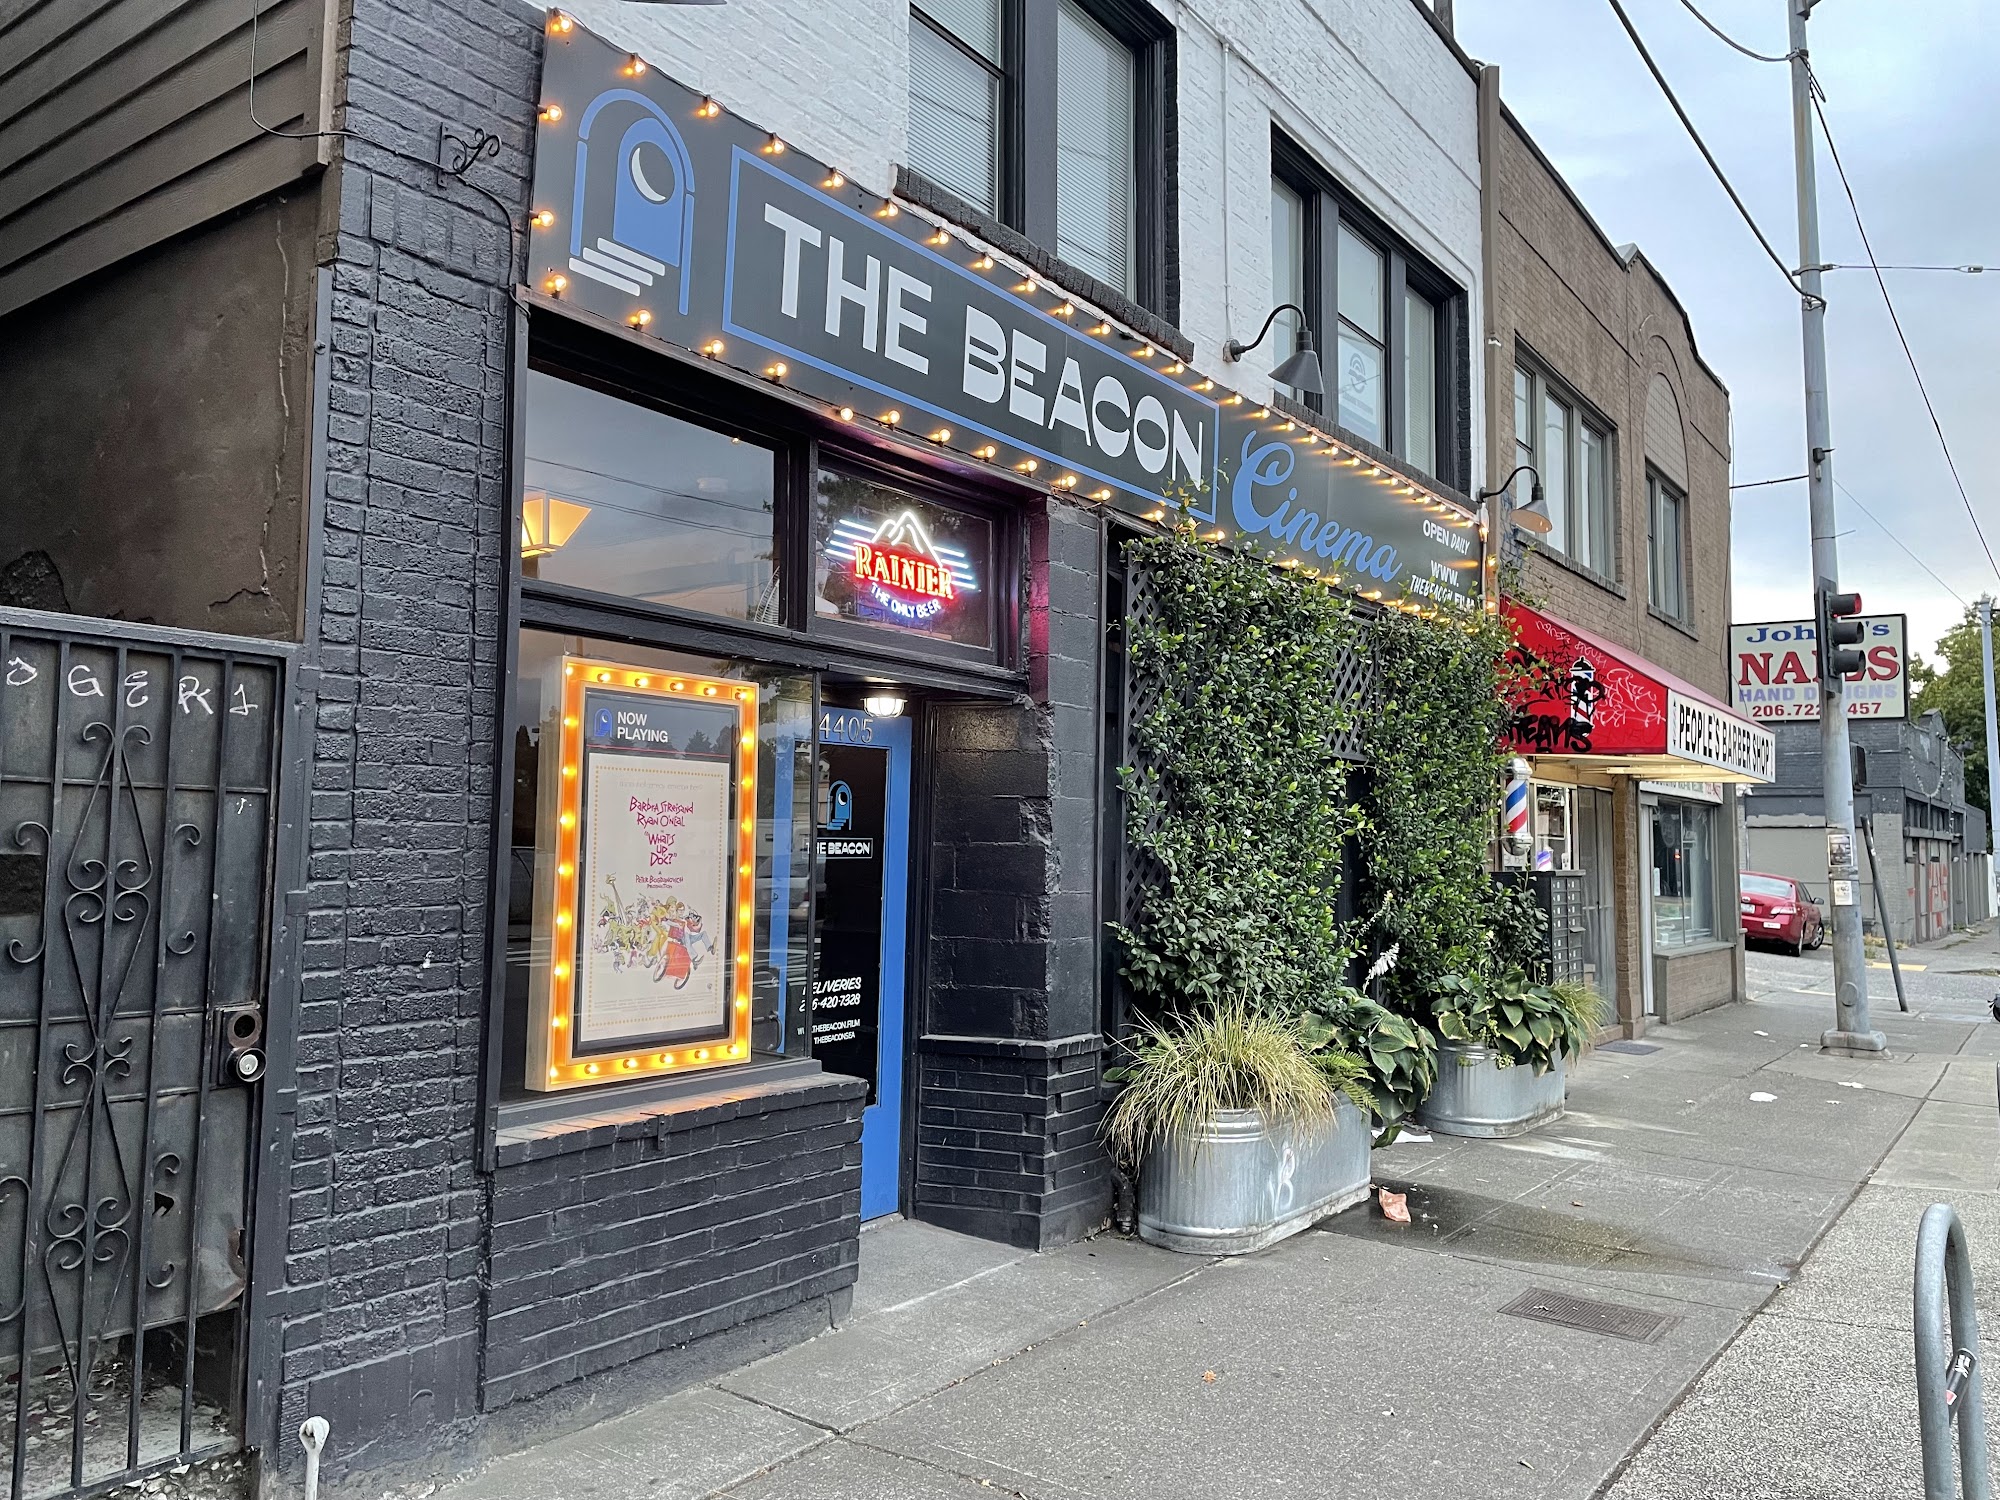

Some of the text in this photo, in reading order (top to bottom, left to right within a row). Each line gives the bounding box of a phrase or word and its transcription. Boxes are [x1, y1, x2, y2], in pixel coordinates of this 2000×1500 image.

[763, 203, 1203, 491] THE BEACON
[1232, 430, 1402, 582] Cinema
[1423, 519, 1470, 555] OPEN DAILY
[853, 542, 954, 600] RAINIER
[1431, 560, 1459, 587] WWW.
[871, 582, 942, 619] THE ONLY BEER
[1738, 646, 1900, 686] NAS
[1739, 684, 1897, 703] HAND DIGNS
[617, 711, 647, 726] NOW
[617, 726, 669, 743] PLAYING
[819, 712, 874, 744] 4405
[1679, 703, 1769, 776] PEOPLE'S BARBER SHOP
[827, 842, 871, 855] BEACON
